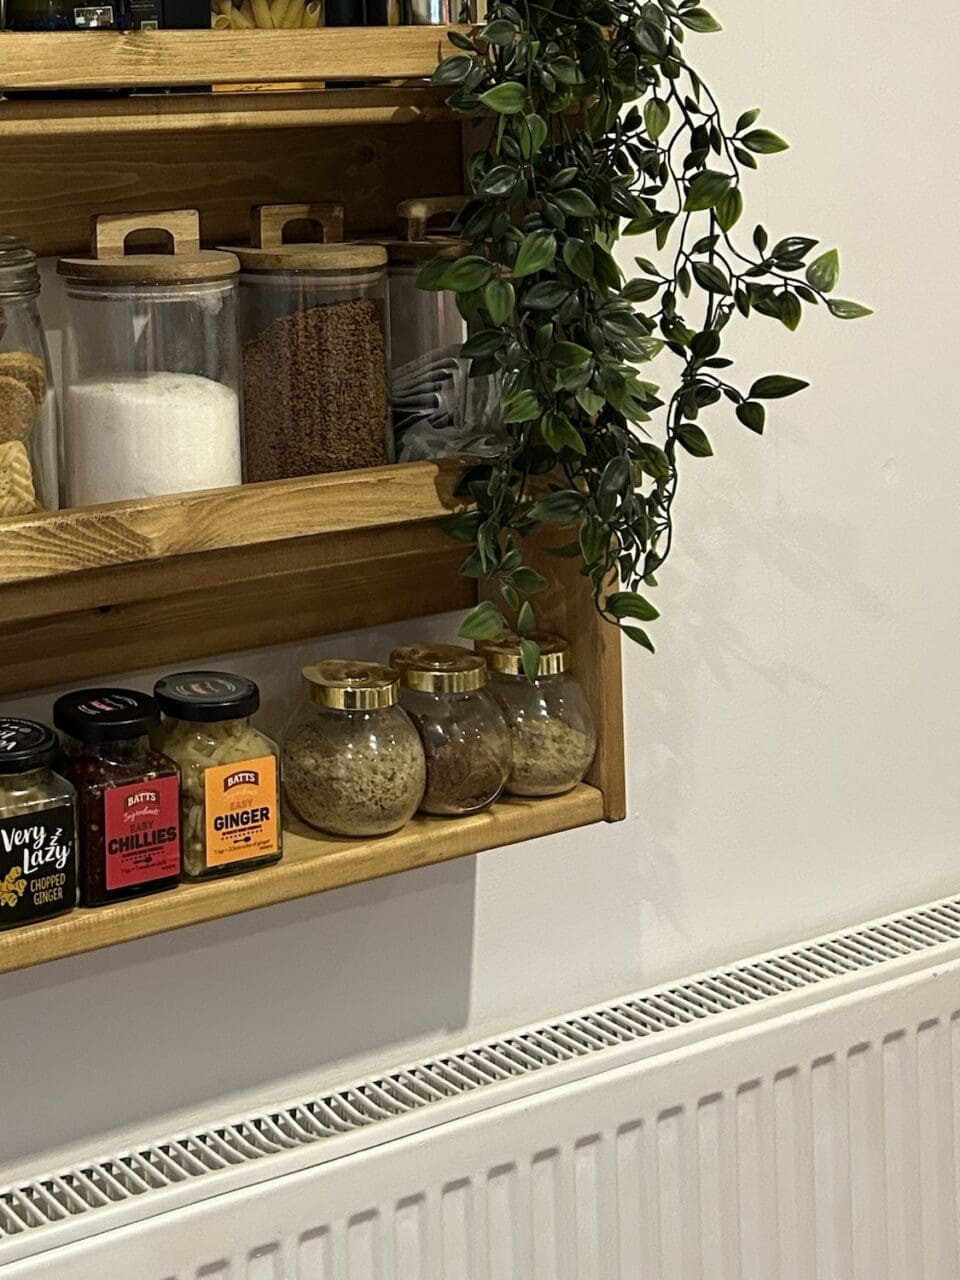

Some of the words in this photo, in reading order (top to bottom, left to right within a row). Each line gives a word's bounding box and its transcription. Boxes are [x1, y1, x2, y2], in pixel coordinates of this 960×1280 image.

[227, 772, 256, 787] BATTS
[127, 792, 157, 808] BATTS
[230, 799, 253, 811] EASY
[213, 806, 271, 832] GINGER
[1, 825, 47, 854] Very
[108, 825, 177, 855] CHILLIES
[23, 845, 70, 875] Lazy
[30, 873, 66, 893] CHOPPED
[33, 887, 64, 906] GINGER
